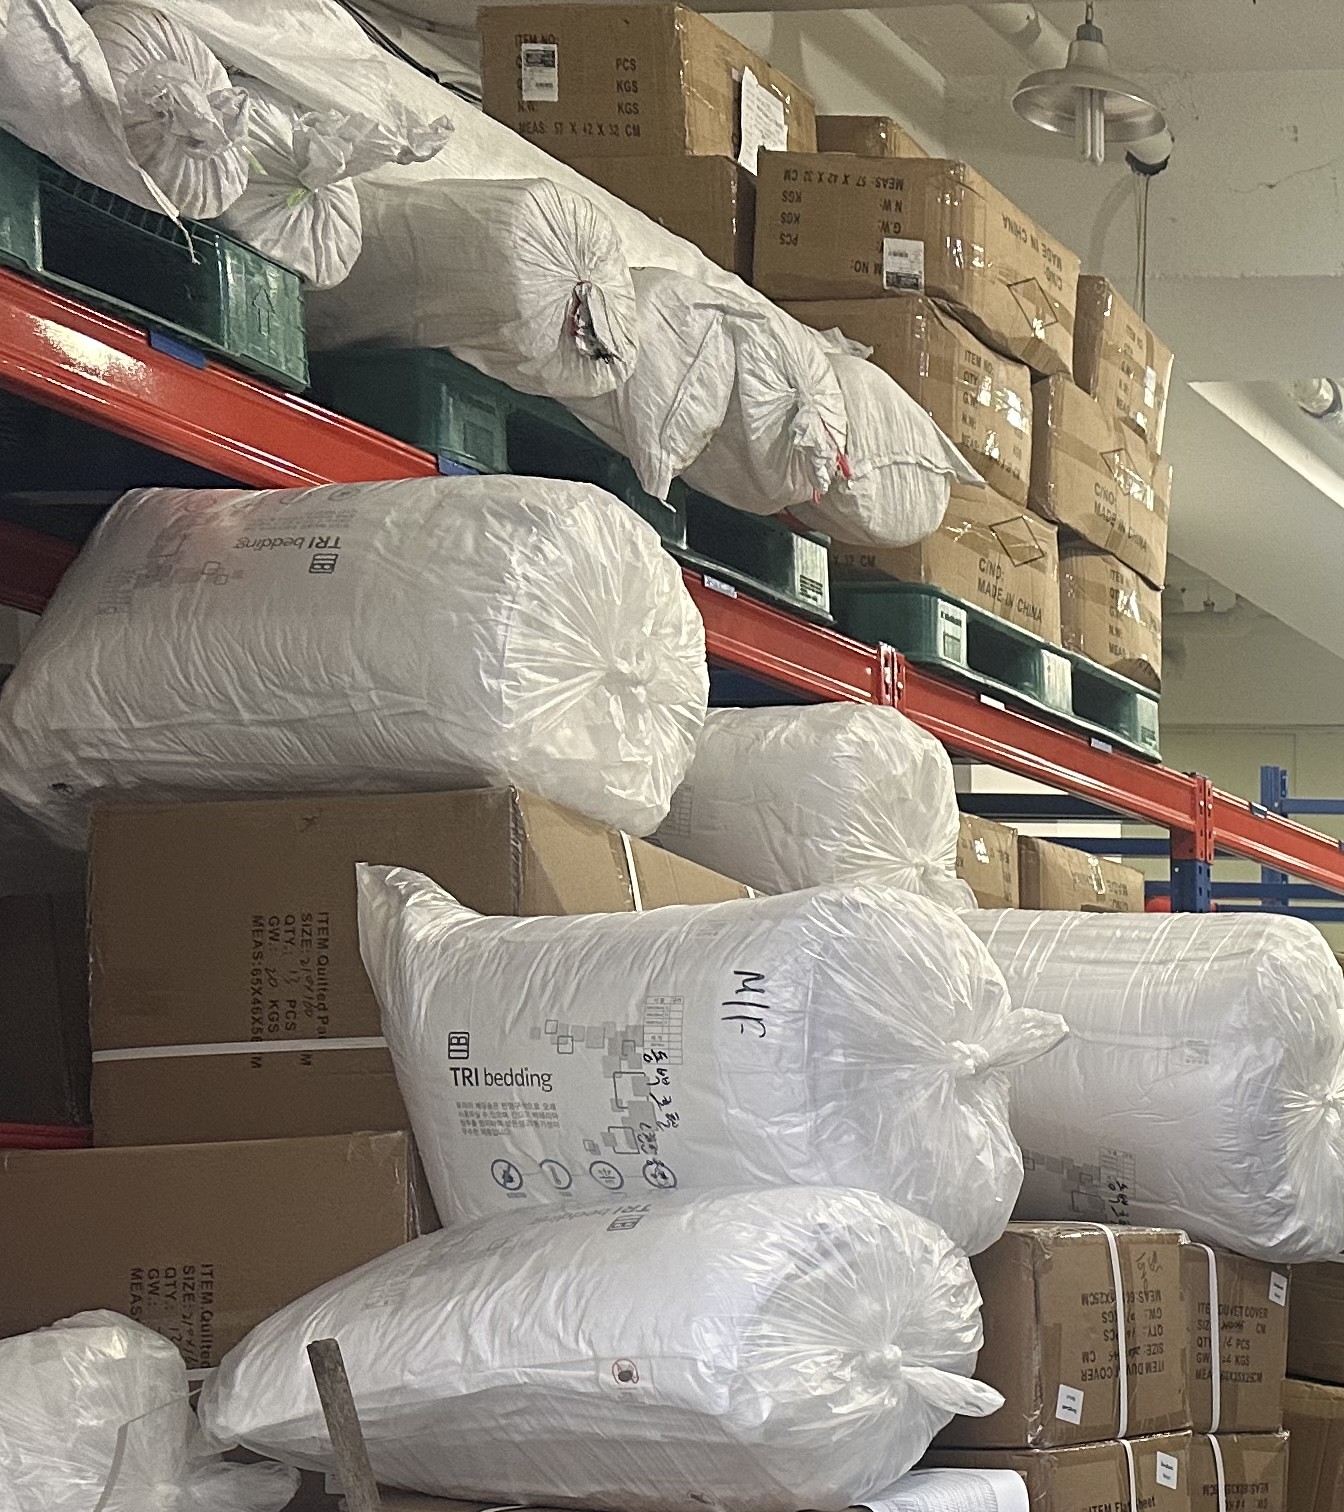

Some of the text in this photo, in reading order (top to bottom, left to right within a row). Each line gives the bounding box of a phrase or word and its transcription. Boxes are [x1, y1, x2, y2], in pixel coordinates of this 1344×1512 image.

[616, 58, 636, 71] PCS
[616, 80, 639, 93] KGS
[617, 102, 639, 115] KGS
[624, 124, 641, 138] CM
[235, 536, 341, 551] TRI bedding
[978, 577, 1042, 623] MADE IN CHINA
[301, 912, 313, 953] SIZE:
[268, 999, 280, 1033] KGS
[285, 999, 297, 1032] PCS
[449, 1066, 553, 1092] TRI bedding
[183, 1265, 195, 1309] SIZE:
[1197, 1302, 1211, 1315] ITE
[1102, 1310, 1118, 1323] GS
[1103, 1328, 1118, 1342] CS
[1081, 1351, 1096, 1364] CM
[1081, 1361, 1165, 1382] ITEM COVER
